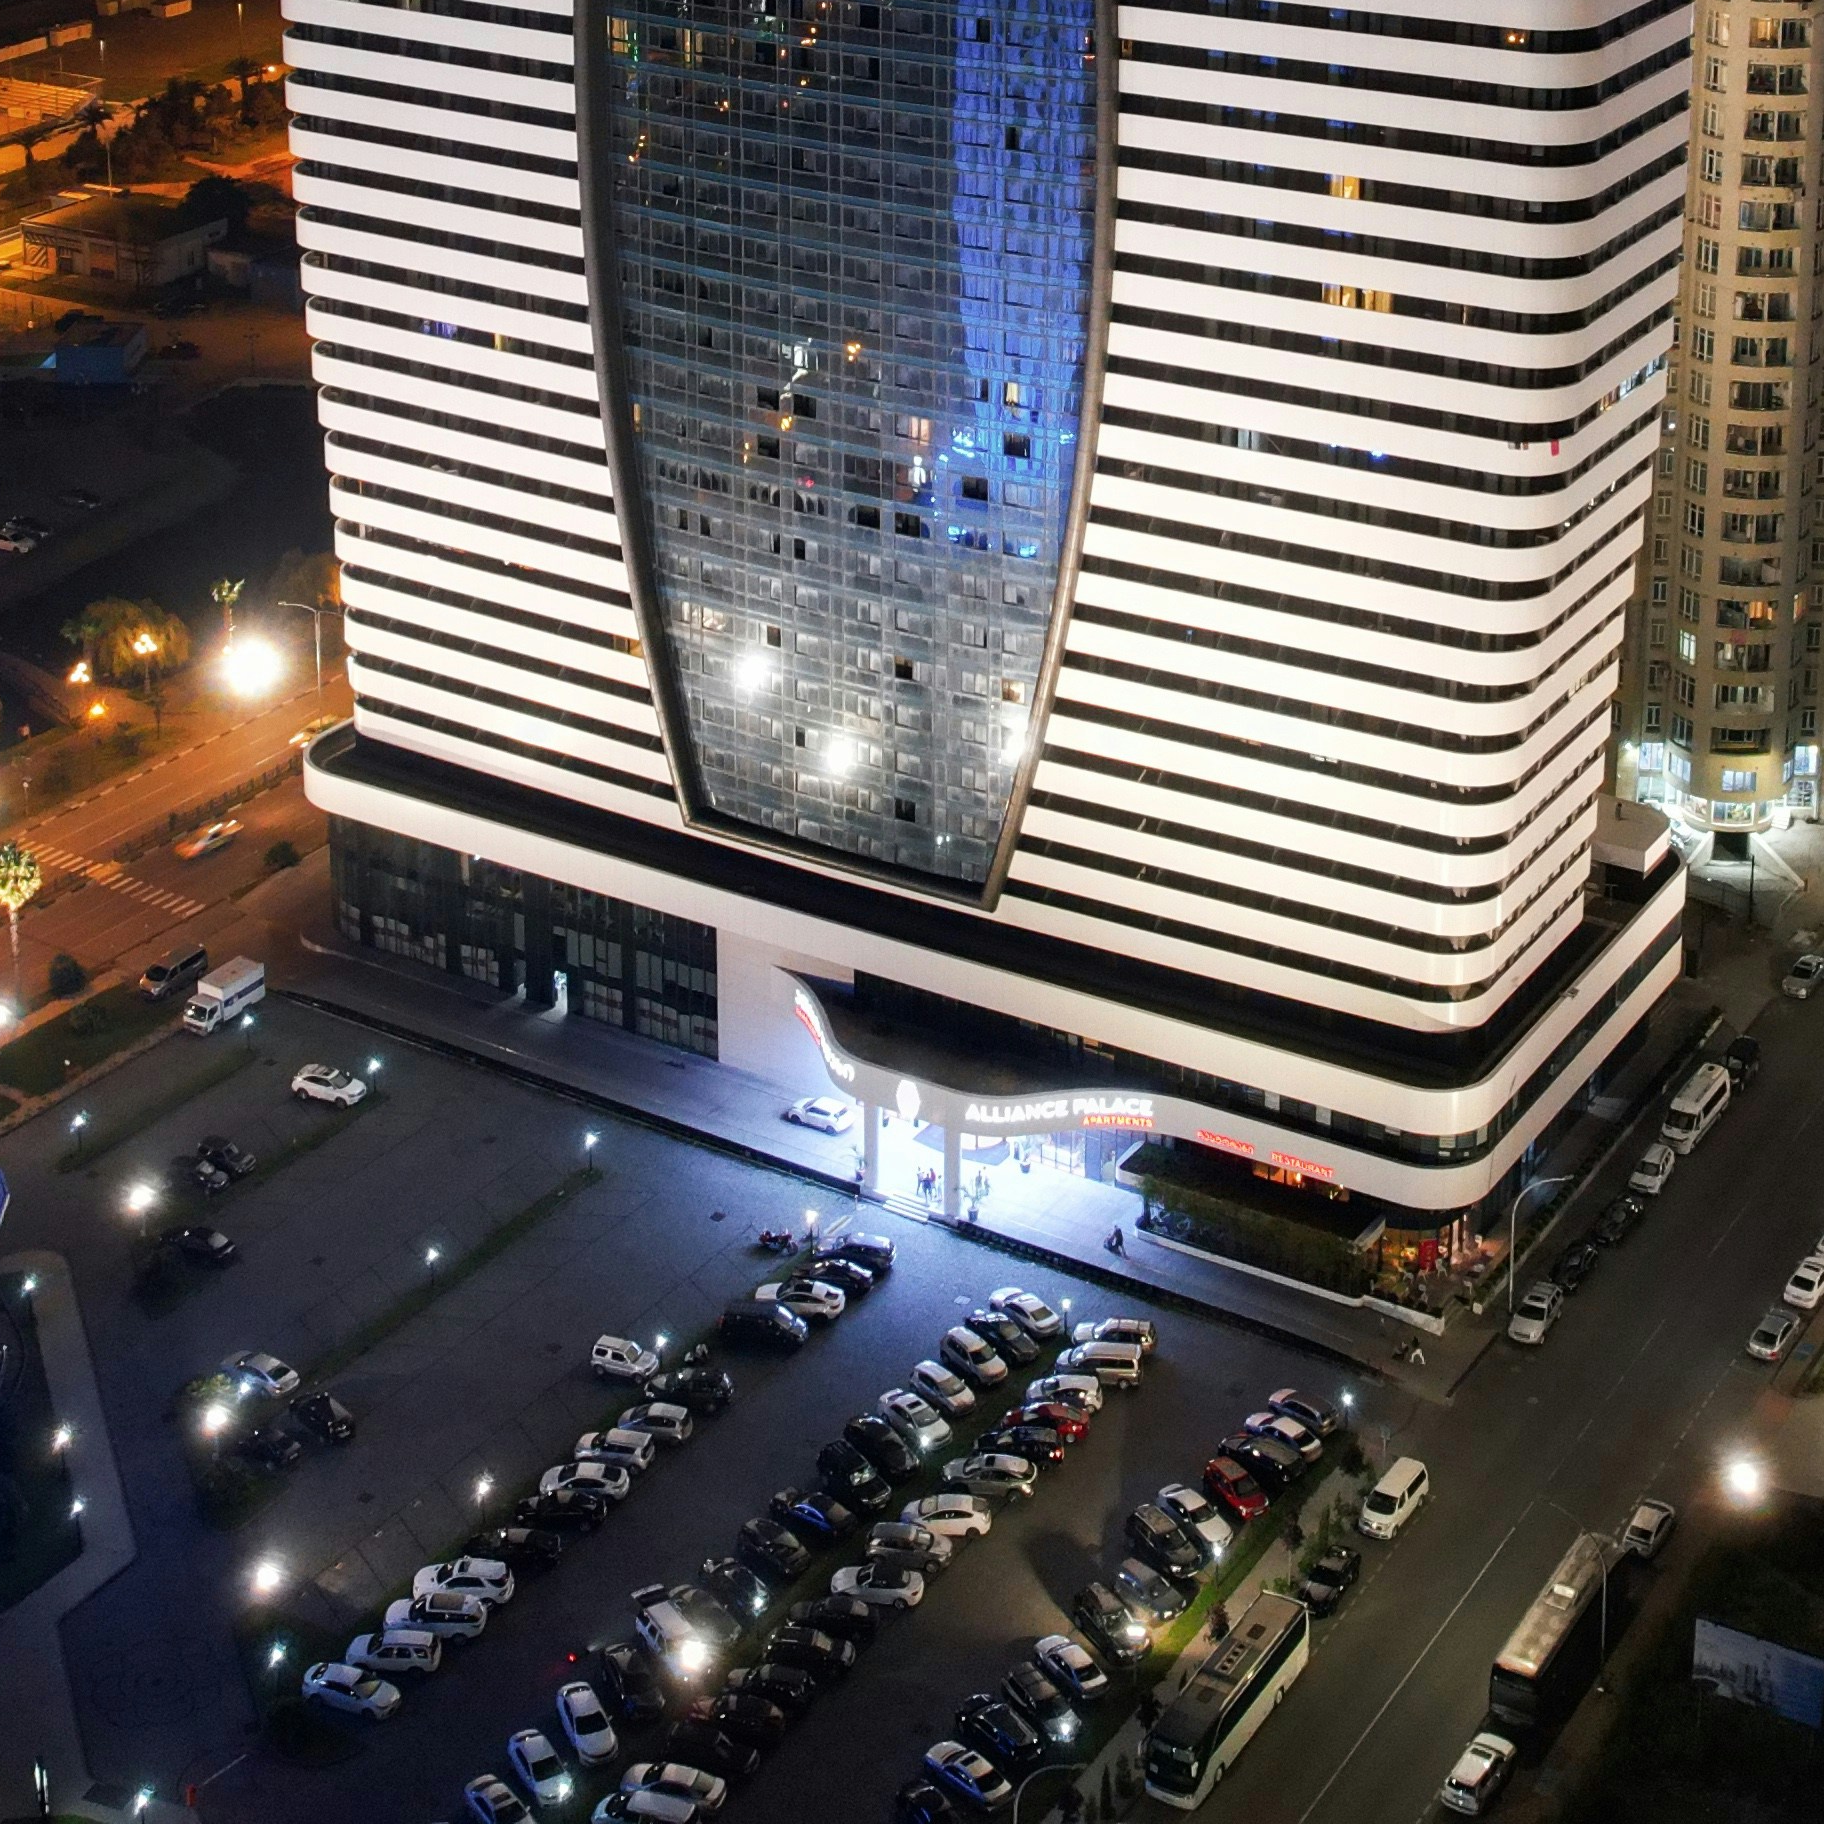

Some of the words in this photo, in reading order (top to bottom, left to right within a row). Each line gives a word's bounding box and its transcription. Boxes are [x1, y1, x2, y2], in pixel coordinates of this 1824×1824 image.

[965, 1100, 1068, 1123] ALLIANCE
[1072, 1097, 1154, 1117] PALACE
[1082, 1116, 1154, 1128] APARTMENTS
[1271, 1152, 1333, 1178] RESTAURANT
